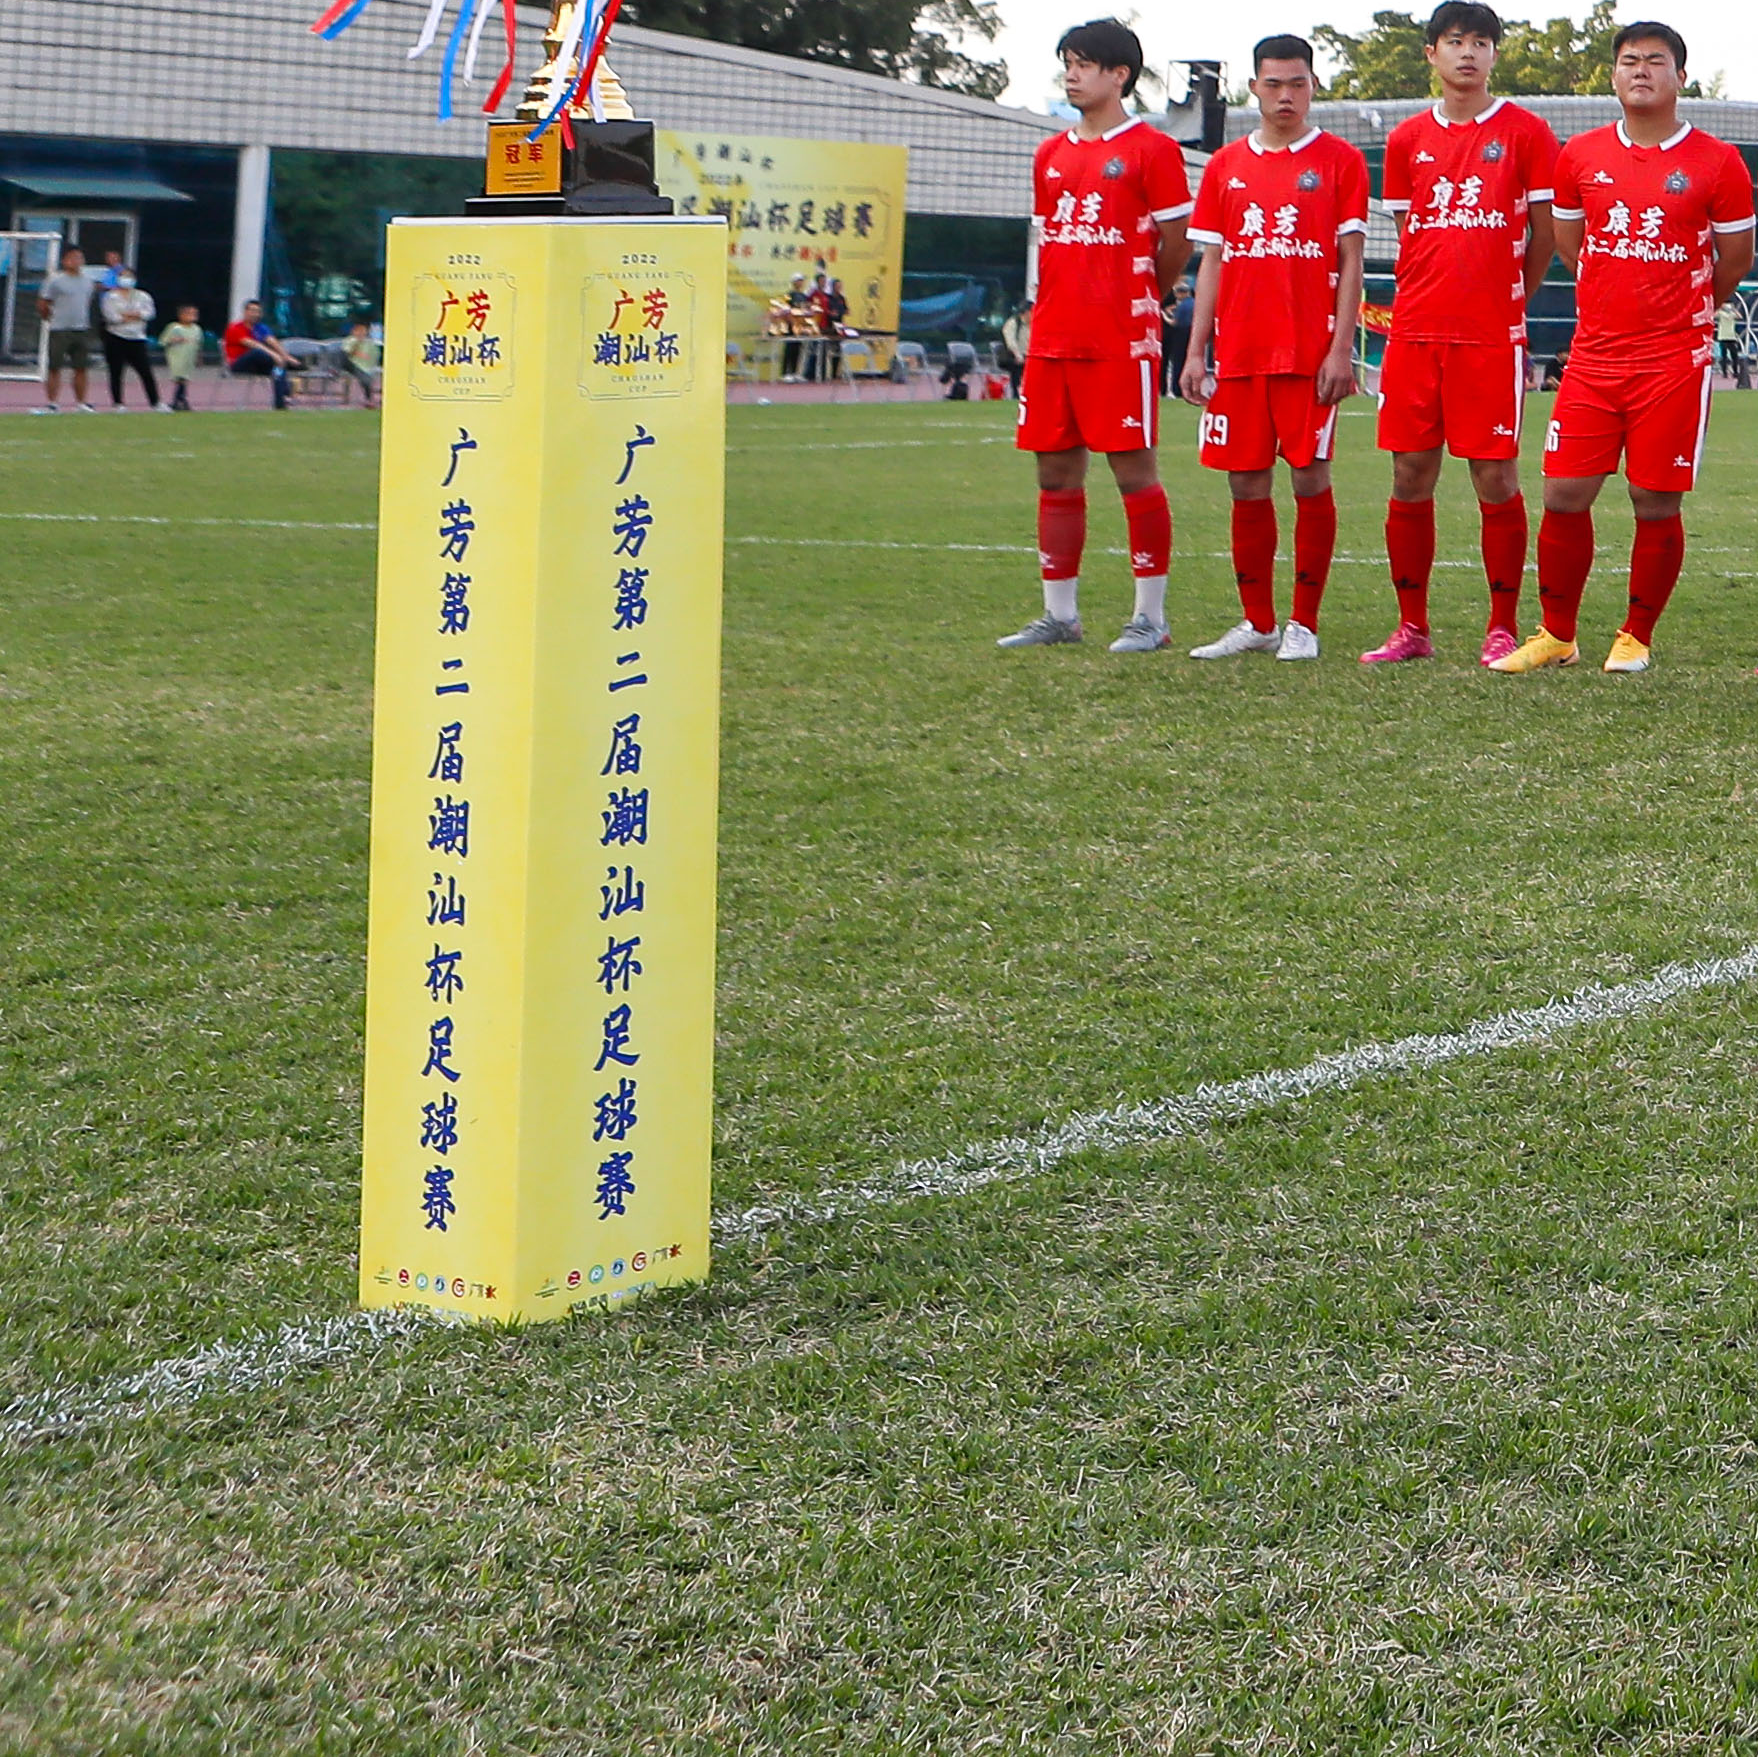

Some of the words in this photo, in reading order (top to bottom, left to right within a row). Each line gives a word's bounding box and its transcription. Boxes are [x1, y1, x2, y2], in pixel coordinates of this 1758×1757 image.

[448, 254, 481, 265] 2022
[622, 254, 657, 264] 2022
[435, 289, 491, 332] 广芳
[608, 288, 669, 330] 广芳
[422, 332, 501, 367] 潮汕杯
[593, 331, 679, 366] 潮汕杯
[1205, 411, 1229, 446] 29
[421, 427, 478, 1232] 广芳第二届潮汕杯足球赛
[592, 423, 656, 1220] 广芳第二届潮汕杯足球赛
